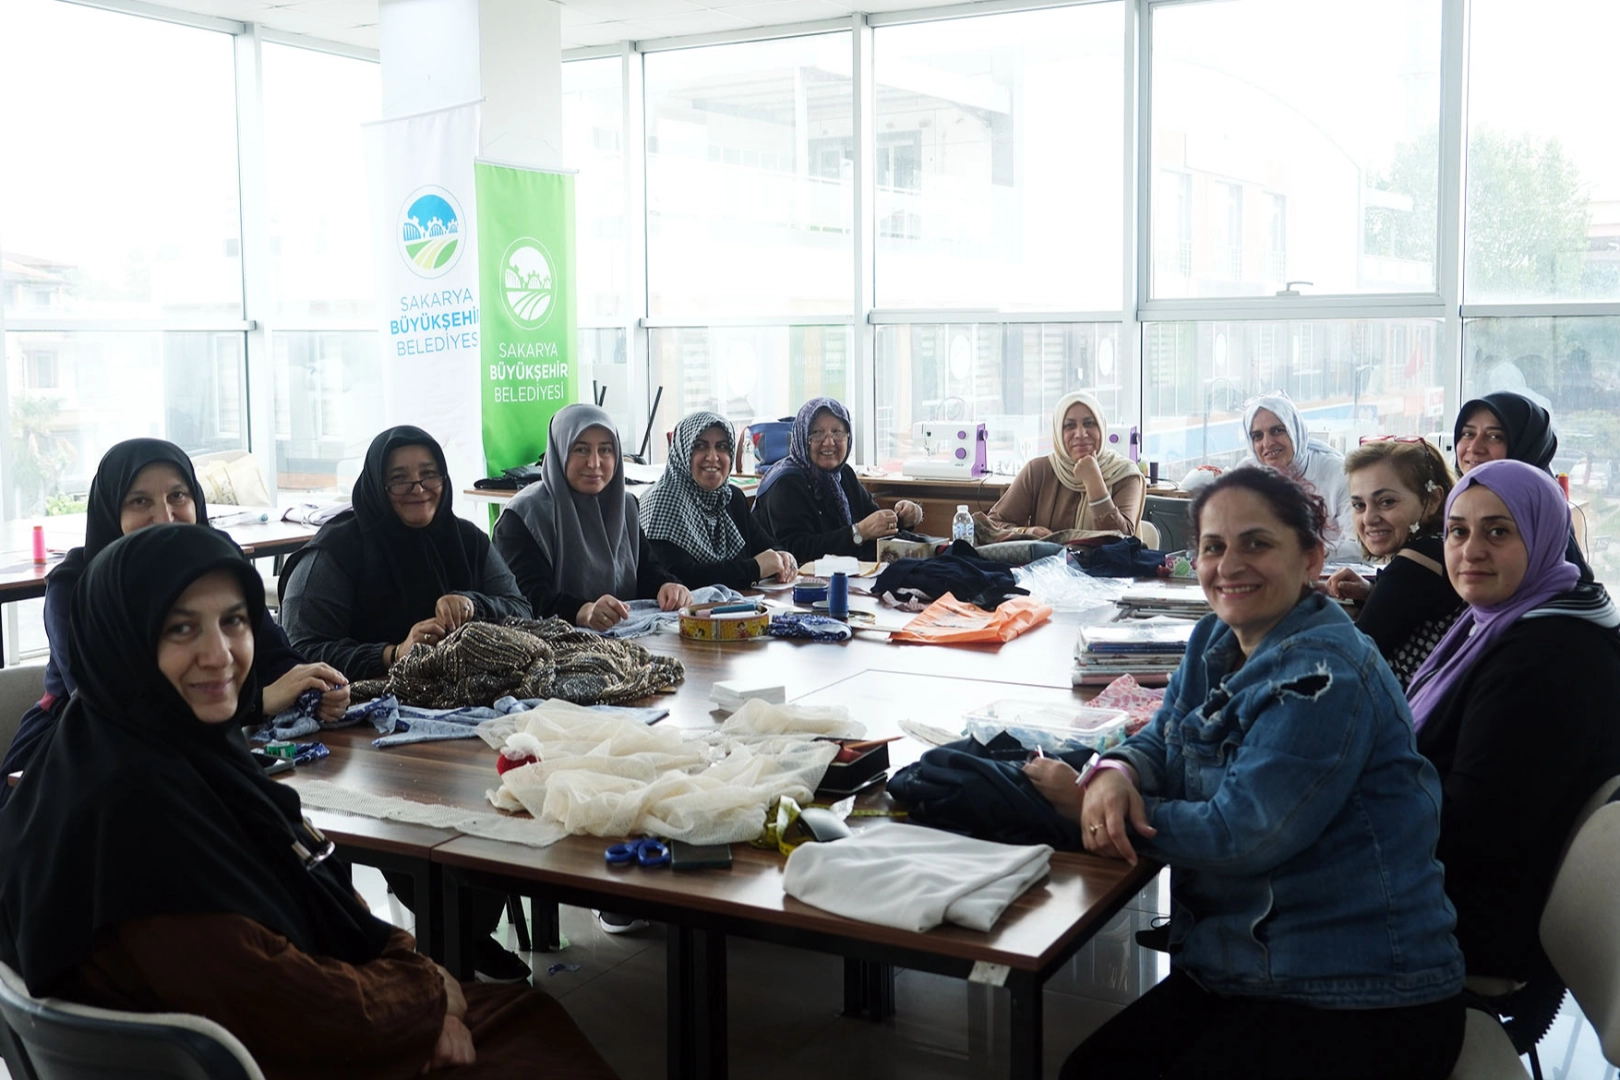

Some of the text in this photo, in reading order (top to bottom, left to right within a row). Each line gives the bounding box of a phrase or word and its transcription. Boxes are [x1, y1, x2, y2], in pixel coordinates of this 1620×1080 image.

[400, 288, 473, 312] SAKARYA
[499, 342, 558, 358] SAKARYA
[490, 360, 568, 382] BÜYÜKŞEHİR
[494, 381, 564, 402] BELEDİYESİ
